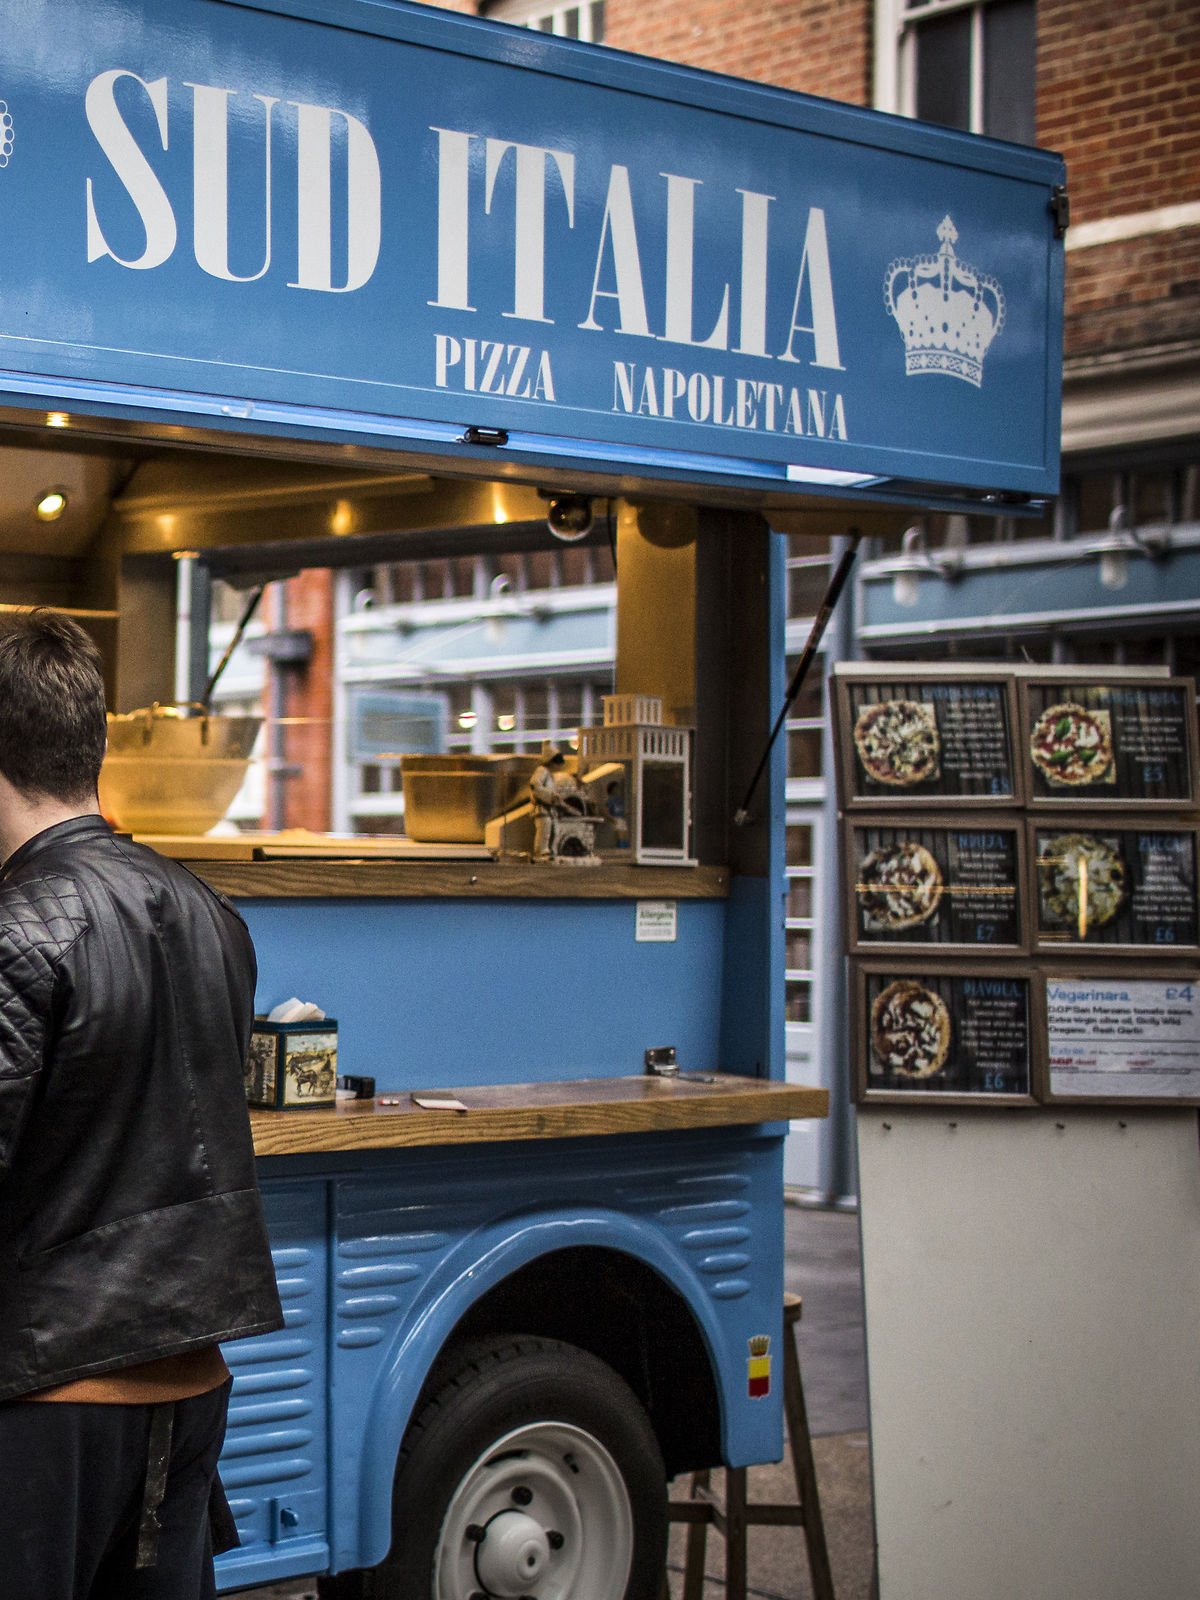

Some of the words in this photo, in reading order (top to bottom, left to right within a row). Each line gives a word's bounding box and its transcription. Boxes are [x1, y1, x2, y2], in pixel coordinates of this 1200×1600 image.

[85, 69, 382, 293] SUD
[427, 126, 847, 371] ITALIA
[433, 334, 557, 402] PIZZA
[611, 360, 849, 441] NAPOLETANA
[976, 923, 995, 941] £7
[1155, 926, 1175, 942] £6
[1165, 986, 1194, 1003] £4
[1133, 1006, 1165, 1015] tomato
[984, 1072, 1005, 1089] £6
